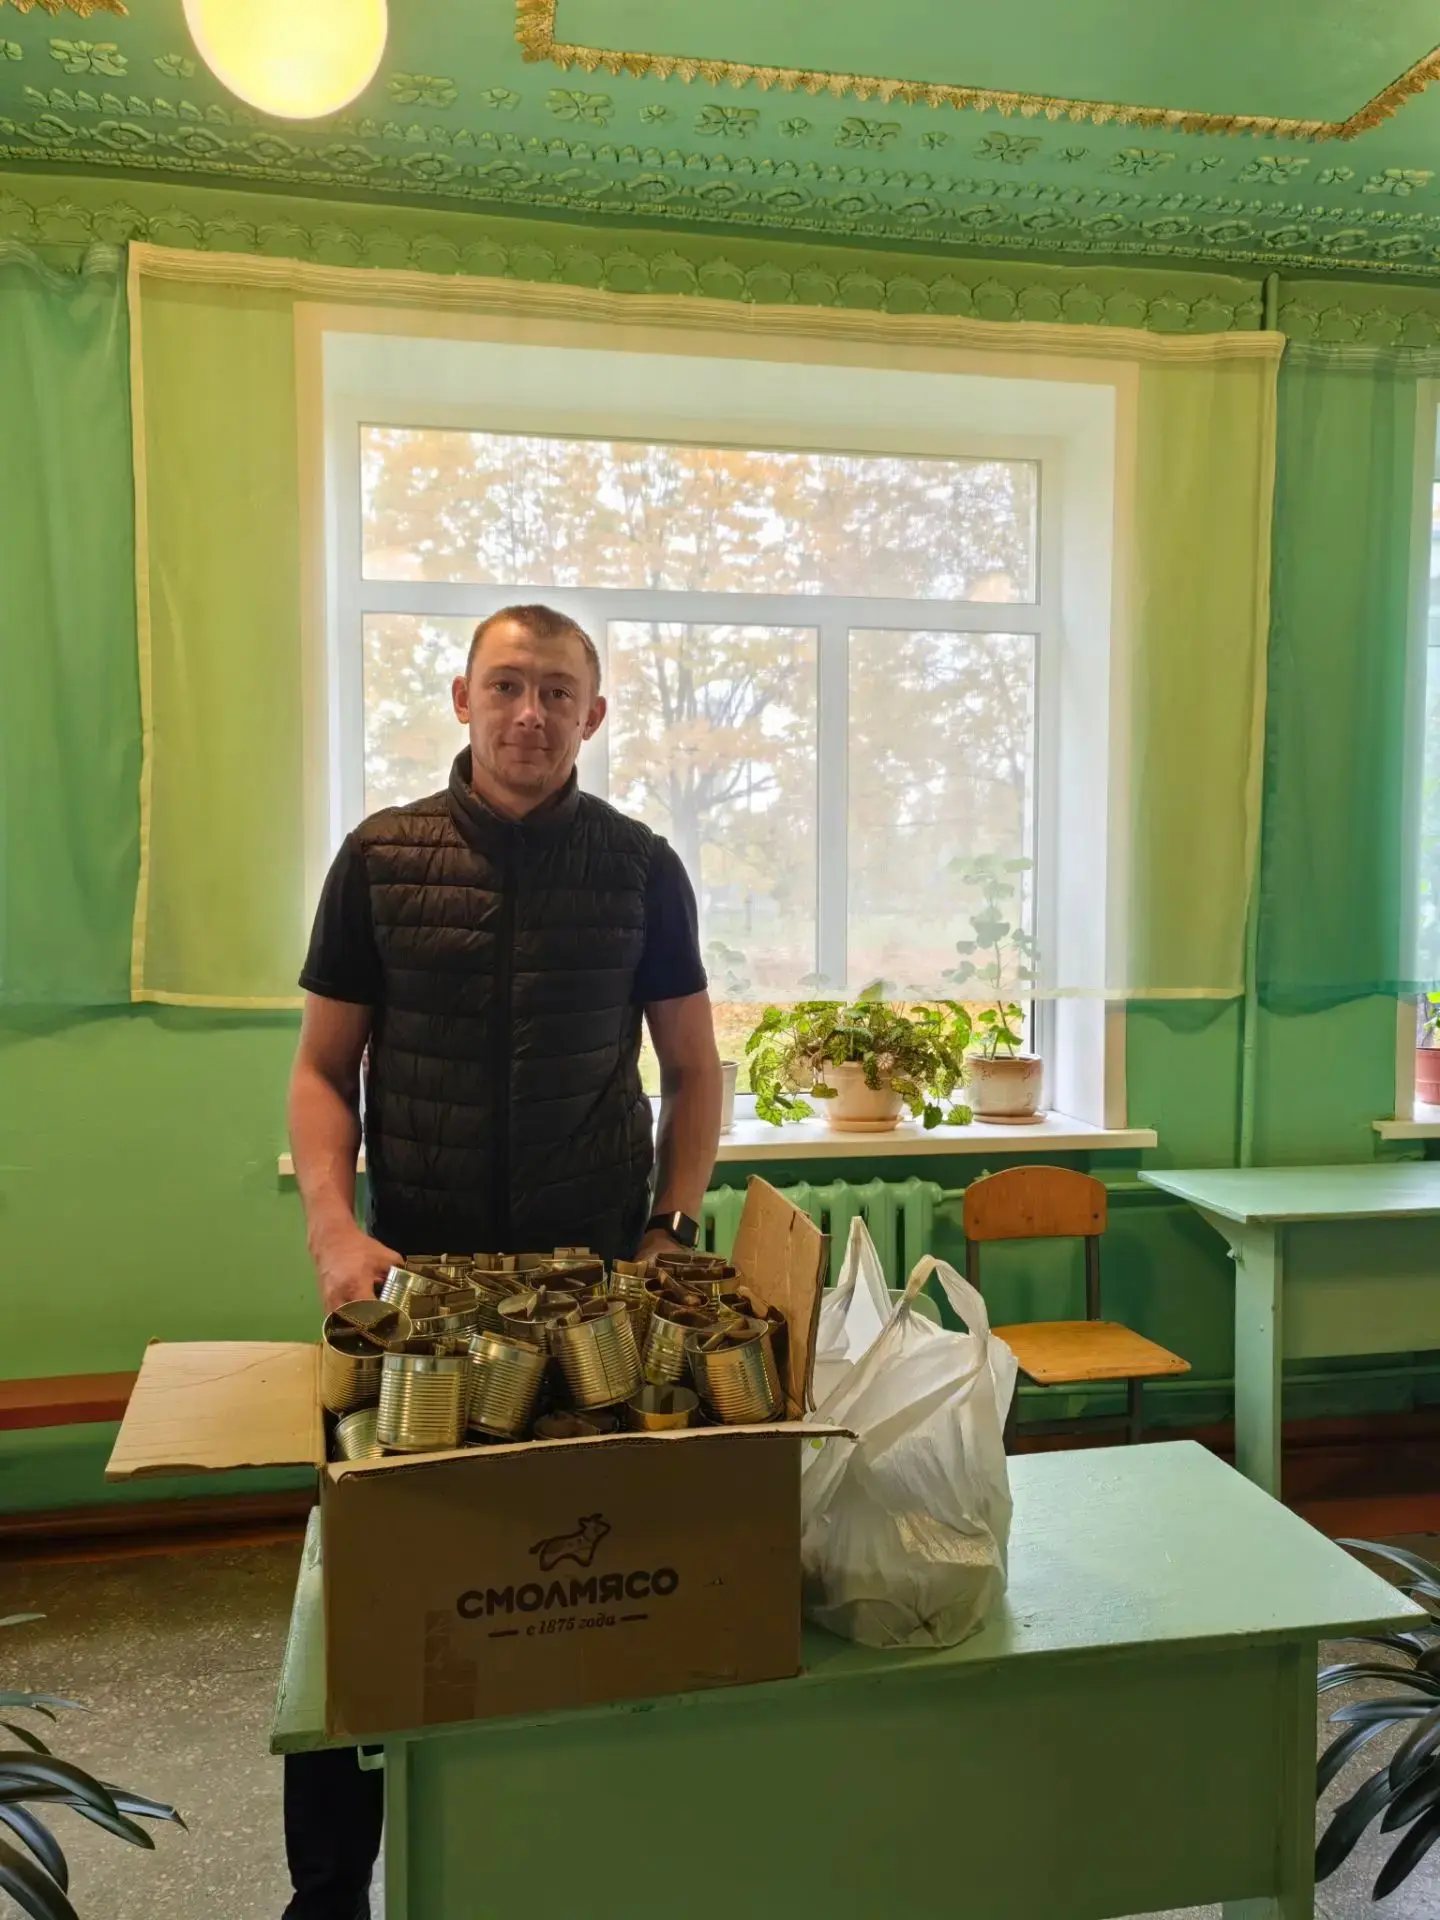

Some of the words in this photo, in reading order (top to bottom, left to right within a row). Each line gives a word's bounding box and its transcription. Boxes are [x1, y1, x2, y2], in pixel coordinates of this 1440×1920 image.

[457, 1567, 679, 1619] СМОЛМЯСО
[526, 1624, 536, 1637] с
[538, 1619, 576, 1634] 1875
[578, 1612, 616, 1629] года
